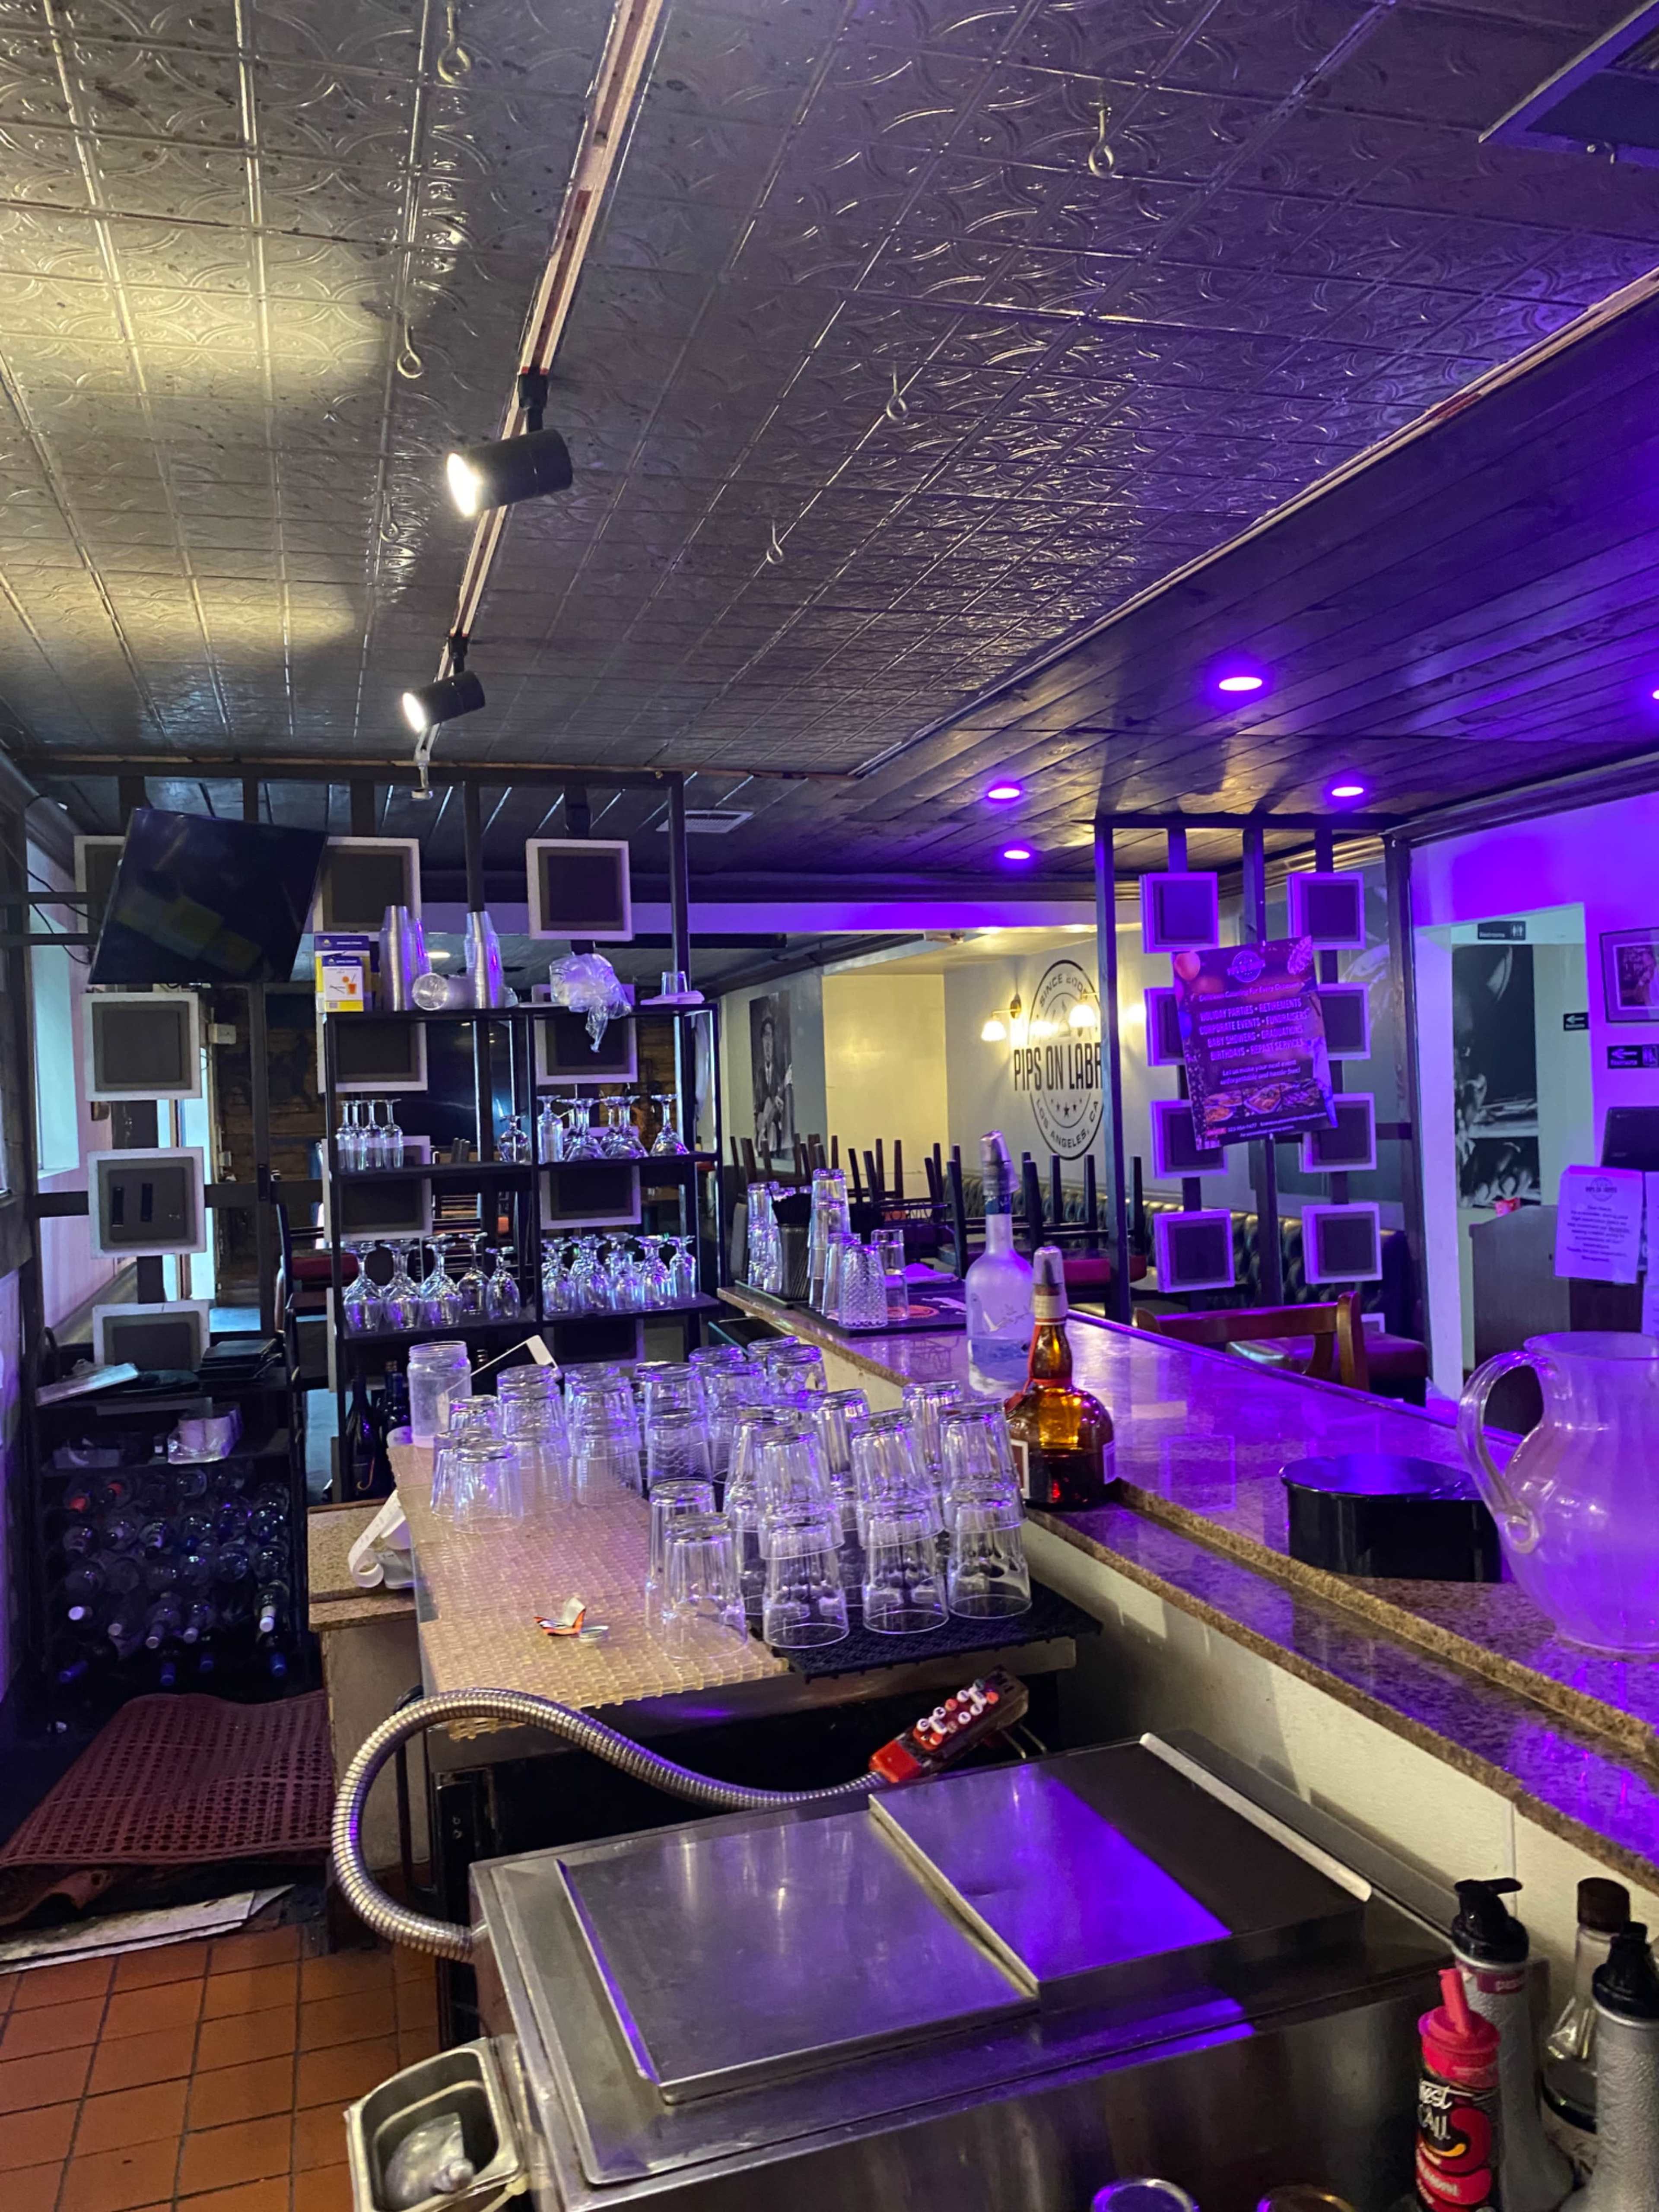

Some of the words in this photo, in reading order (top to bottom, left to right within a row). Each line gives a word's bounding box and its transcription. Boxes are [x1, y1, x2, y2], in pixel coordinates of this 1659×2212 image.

[1039, 973, 1063, 1007] SINCE
[1228, 1005, 1254, 1018] PARTIES
[1259, 998, 1302, 1013] RETIREMENTS
[1236, 1017, 1261, 1030] EVENTS
[1208, 1037, 1224, 1048] BABY
[1211, 1047, 1246, 1062] BIRTHDAYS
[1014, 1046, 1042, 1091] PIPS
[1046, 1045, 1064, 1090] ON
[1089, 1101, 1099, 1123] CA
